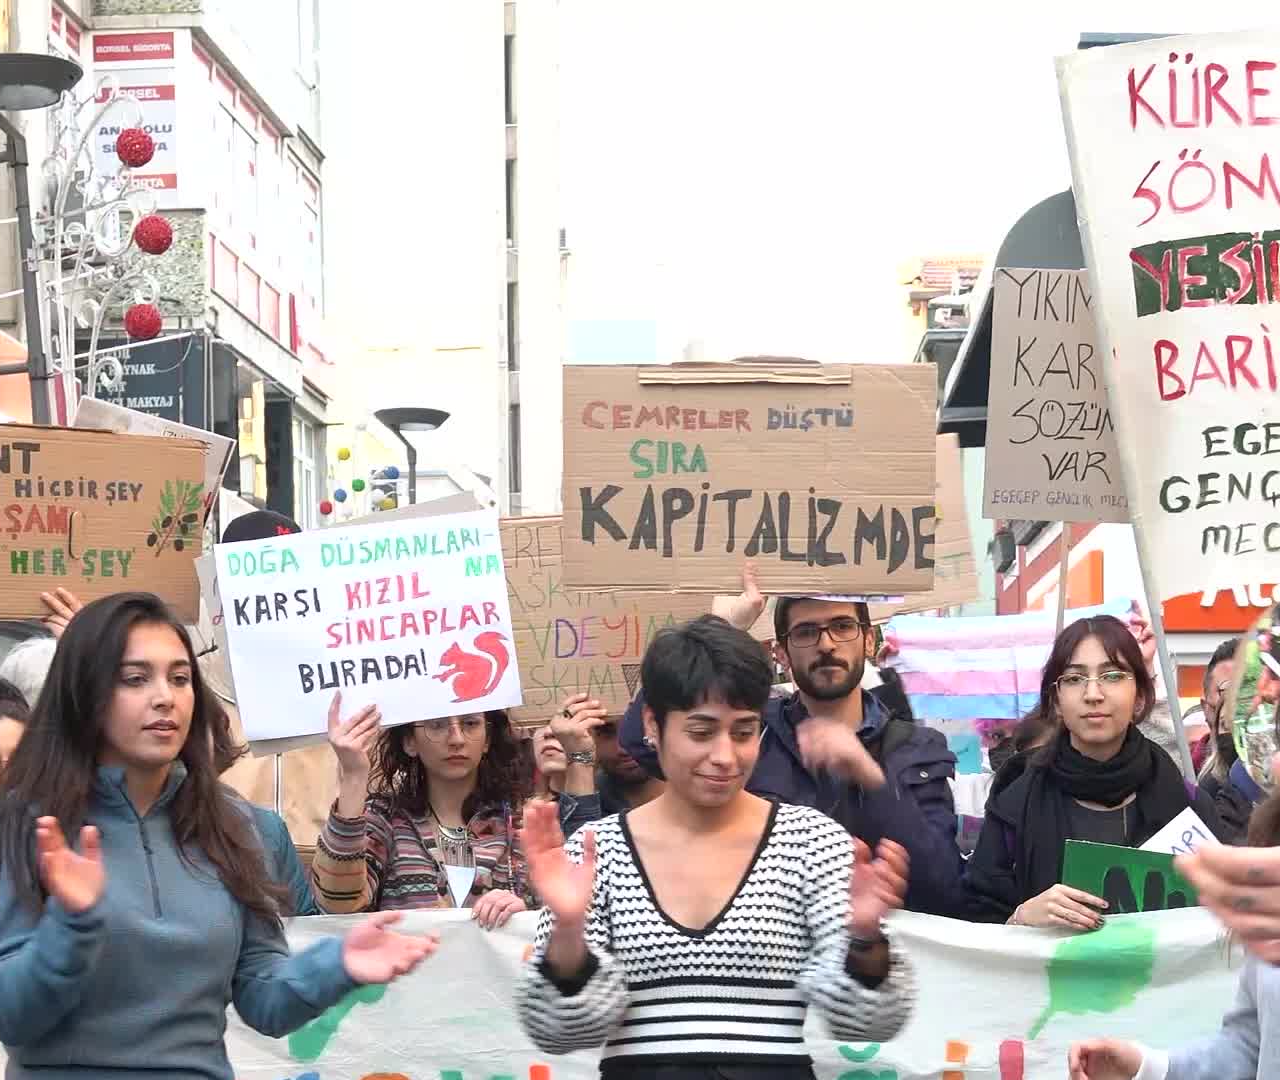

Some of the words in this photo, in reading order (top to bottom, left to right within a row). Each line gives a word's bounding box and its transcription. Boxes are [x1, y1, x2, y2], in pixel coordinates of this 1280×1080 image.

[581, 400, 752, 432] CEMRELER
[766, 402, 855, 432] DÜŞTÜ
[629, 438, 708, 479] SIRA
[1041, 450, 1112, 484] VAR
[14, 474, 99, 501] HİÇBİR
[104, 481, 144, 508] ŞEY
[578, 481, 936, 575] KAPİTALİZMDE
[227, 545, 300, 577] DOĞA
[464, 554, 503, 577] NA
[233, 587, 322, 626] KARŞI
[345, 571, 431, 611] KIZIL
[326, 601, 501, 649] SİNCAPLAR
[297, 648, 429, 694] BURADA!
